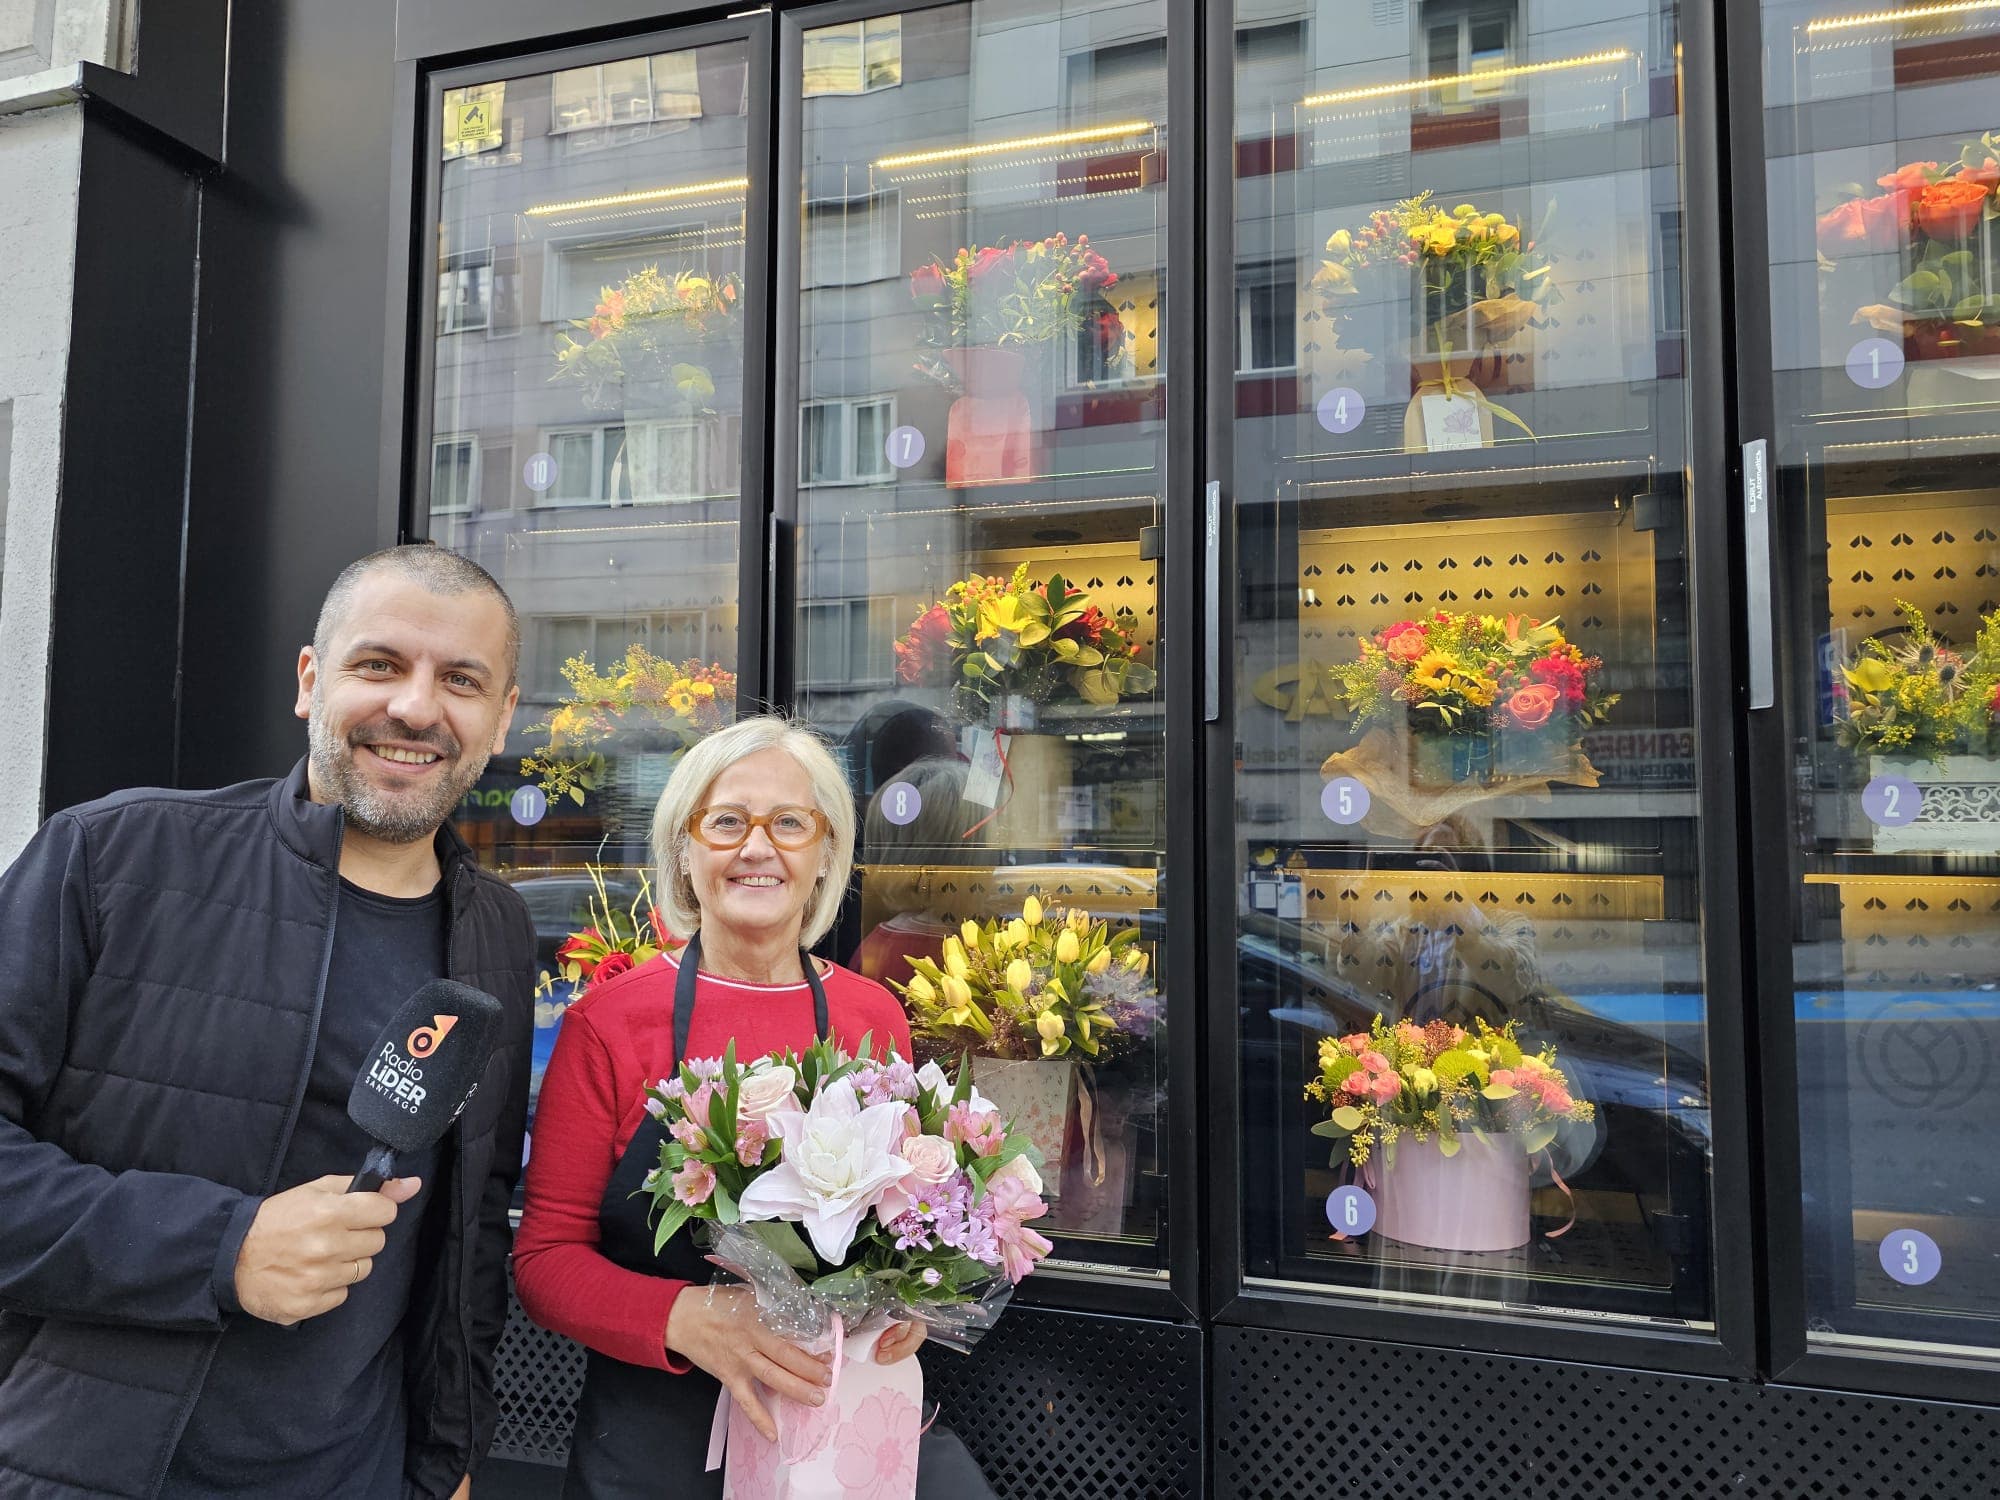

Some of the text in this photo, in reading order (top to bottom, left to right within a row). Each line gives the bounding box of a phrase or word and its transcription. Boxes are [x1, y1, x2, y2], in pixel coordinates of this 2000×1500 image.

[1869, 348, 1880, 379] 1
[1334, 396, 1348, 425] 4
[901, 433, 914, 460] 7
[531, 459, 549, 485] 10
[519, 793, 535, 818] 11
[896, 790, 907, 817] 8
[1339, 786, 1353, 816] 5
[1884, 785, 1901, 818] 2
[380, 1041, 423, 1081] Radio
[365, 1075, 418, 1114] SANTIAGO
[1345, 1195, 1359, 1226] 6
[1901, 1240, 1919, 1275] 3
